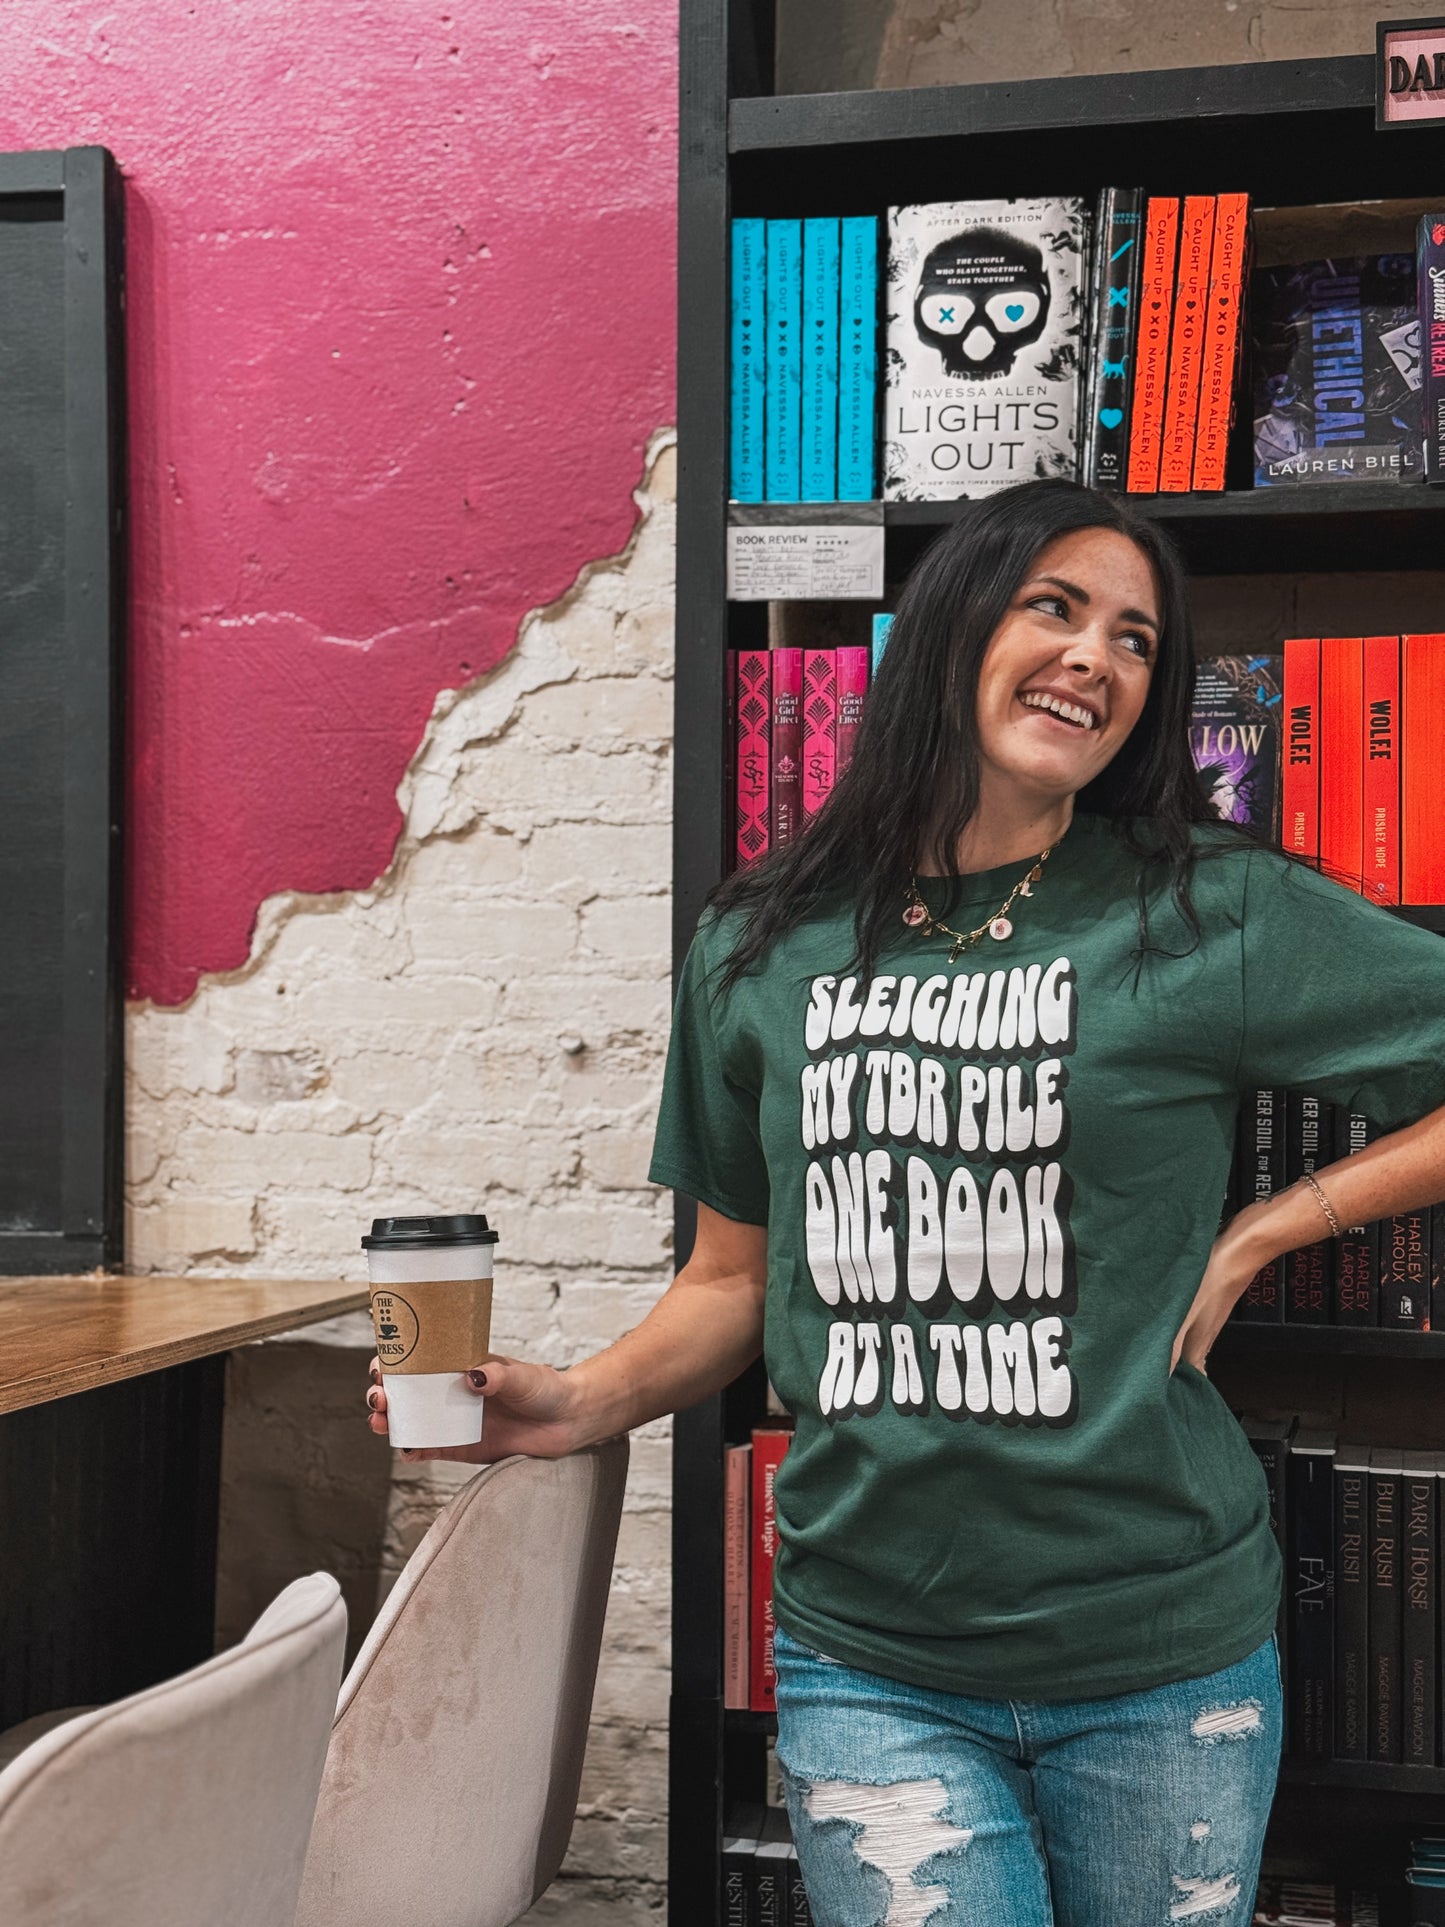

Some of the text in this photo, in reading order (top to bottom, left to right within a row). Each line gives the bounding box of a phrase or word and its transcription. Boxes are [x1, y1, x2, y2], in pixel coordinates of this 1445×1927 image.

[926, 214, 1043, 227] AFTER DARK EDITION
[743, 236, 751, 311] LIGHTS OUT
[779, 237, 787, 312] LIGHTS OUT
[816, 236, 825, 311] LIGHTS OUT
[854, 235, 863, 310] LIGHTS OUT
[947, 276, 1015, 285] STAYS TOGETHER
[973, 256, 1005, 264] COUPLE
[1153, 219, 1167, 295] CAUGHT UP
[1188, 218, 1203, 294] CAUGHT UP
[1221, 214, 1235, 291] CAUGHT UP
[912, 386, 1048, 399] NAVESSA ALLEN
[1311, 276, 1366, 448] UNETHICAL
[742, 363, 750, 464] NAVESSA ALLEN
[778, 364, 787, 465] NAVESSA ALLEN
[814, 363, 823, 464] NAVESSA ALLEN
[851, 362, 861, 464] NAVESSA ALLEN
[899, 402, 1059, 434] LIGHTS
[1141, 347, 1157, 454] NAVESSA ALLEN
[1174, 346, 1191, 453] NAVESSA ALLEN
[1207, 343, 1224, 450] NAVESSA ALLEN
[931, 441, 1025, 471] OUT
[1268, 453, 1414, 476] LAUREN BIEL
[736, 535, 808, 545] BOOK REVIEW
[775, 696, 798, 705] Good
[775, 714, 798, 724] Effect
[779, 705, 794, 715] Girl
[839, 696, 863, 705] Good
[843, 705, 859, 715] Girl
[1200, 724, 1267, 757] LOW
[778, 803, 788, 840] SARA
[1375, 846, 1386, 869] HOPE
[804, 956, 1073, 1051] SLEIGHING
[802, 1050, 1063, 1152] MY TBR PILE
[1257, 1091, 1273, 1119] HER
[1256, 1119, 1272, 1152] SOUL
[1257, 1155, 1269, 1171] FOR
[1302, 1121, 1318, 1155] SOUL
[1350, 1121, 1366, 1155] SOUL
[806, 1150, 1064, 1306] ONE BOOK
[1392, 1214, 1405, 1283] LAROUX
[1408, 1217, 1423, 1284] HARLEY
[376, 1297, 393, 1307] THE
[1263, 1264, 1276, 1307] RLEY
[1341, 1242, 1354, 1311] LAROUX
[1357, 1246, 1370, 1311] HARLEY
[378, 1344, 404, 1354] PRESS
[819, 1316, 1072, 1418] AT A TIME
[761, 1515, 775, 1557] Anger
[1340, 1478, 1360, 1583] BULL RUSH
[1372, 1482, 1394, 1587] BULL RUSH
[1408, 1484, 1430, 1610] DARK HORSE
[1295, 1556, 1325, 1614] FAE
[1326, 1570, 1335, 1599] DARK
[763, 1637, 773, 1676] MILLER
[1379, 1655, 1390, 1753] MAGGIE RAWDON
[1413, 1658, 1424, 1756] MAGGIE RAWDON
